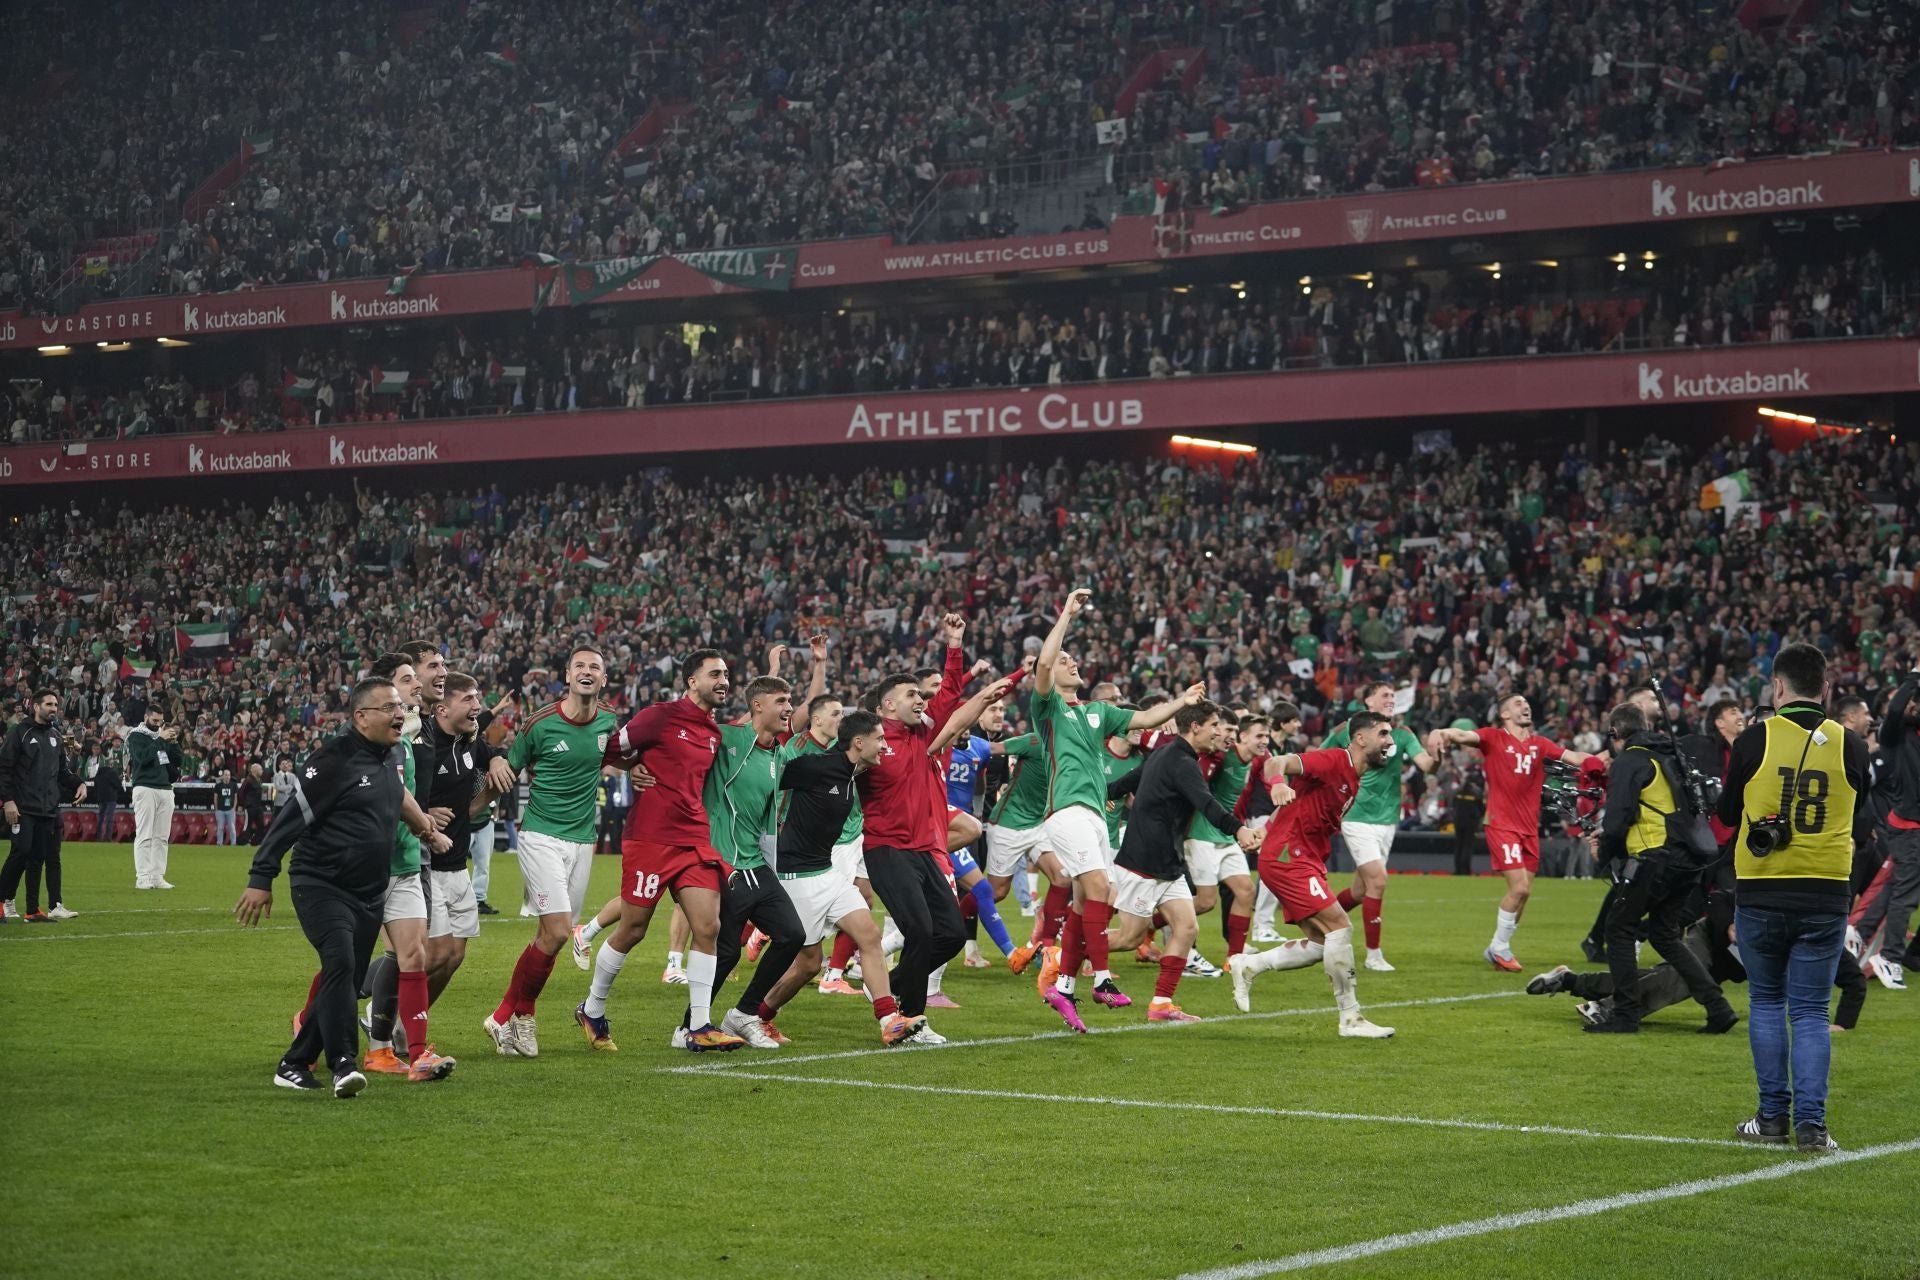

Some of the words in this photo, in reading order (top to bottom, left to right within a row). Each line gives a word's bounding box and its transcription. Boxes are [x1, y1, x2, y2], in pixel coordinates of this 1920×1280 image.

[1687, 180, 1823, 214] kutxabank
[1382, 213, 1457, 230] ATHLETIC
[1462, 208, 1507, 223] CLUB
[1259, 225, 1301, 240] CLUB
[884, 239, 1109, 270] WWW.ATHLETIC-CLUB.EUS
[800, 263, 835, 277] CLUB
[627, 278, 661, 290] CLUB
[205, 306, 286, 329] kutxabank
[353, 294, 439, 318] kutxabank
[66, 311, 152, 332] CASTORE
[1673, 367, 1810, 398] kutxabank
[845, 403, 1022, 440] ATHLETIC
[1038, 393, 1144, 430] CLUB
[64, 452, 151, 471] STORE
[210, 449, 291, 471] kutxabank
[352, 441, 438, 464] kutxabank
[949, 762, 970, 783] 22
[1514, 752, 1532, 775] 14
[1778, 766, 1829, 834] 18
[1502, 843, 1522, 864] 14
[632, 870, 660, 899] 18
[1309, 876, 1329, 900] 4
